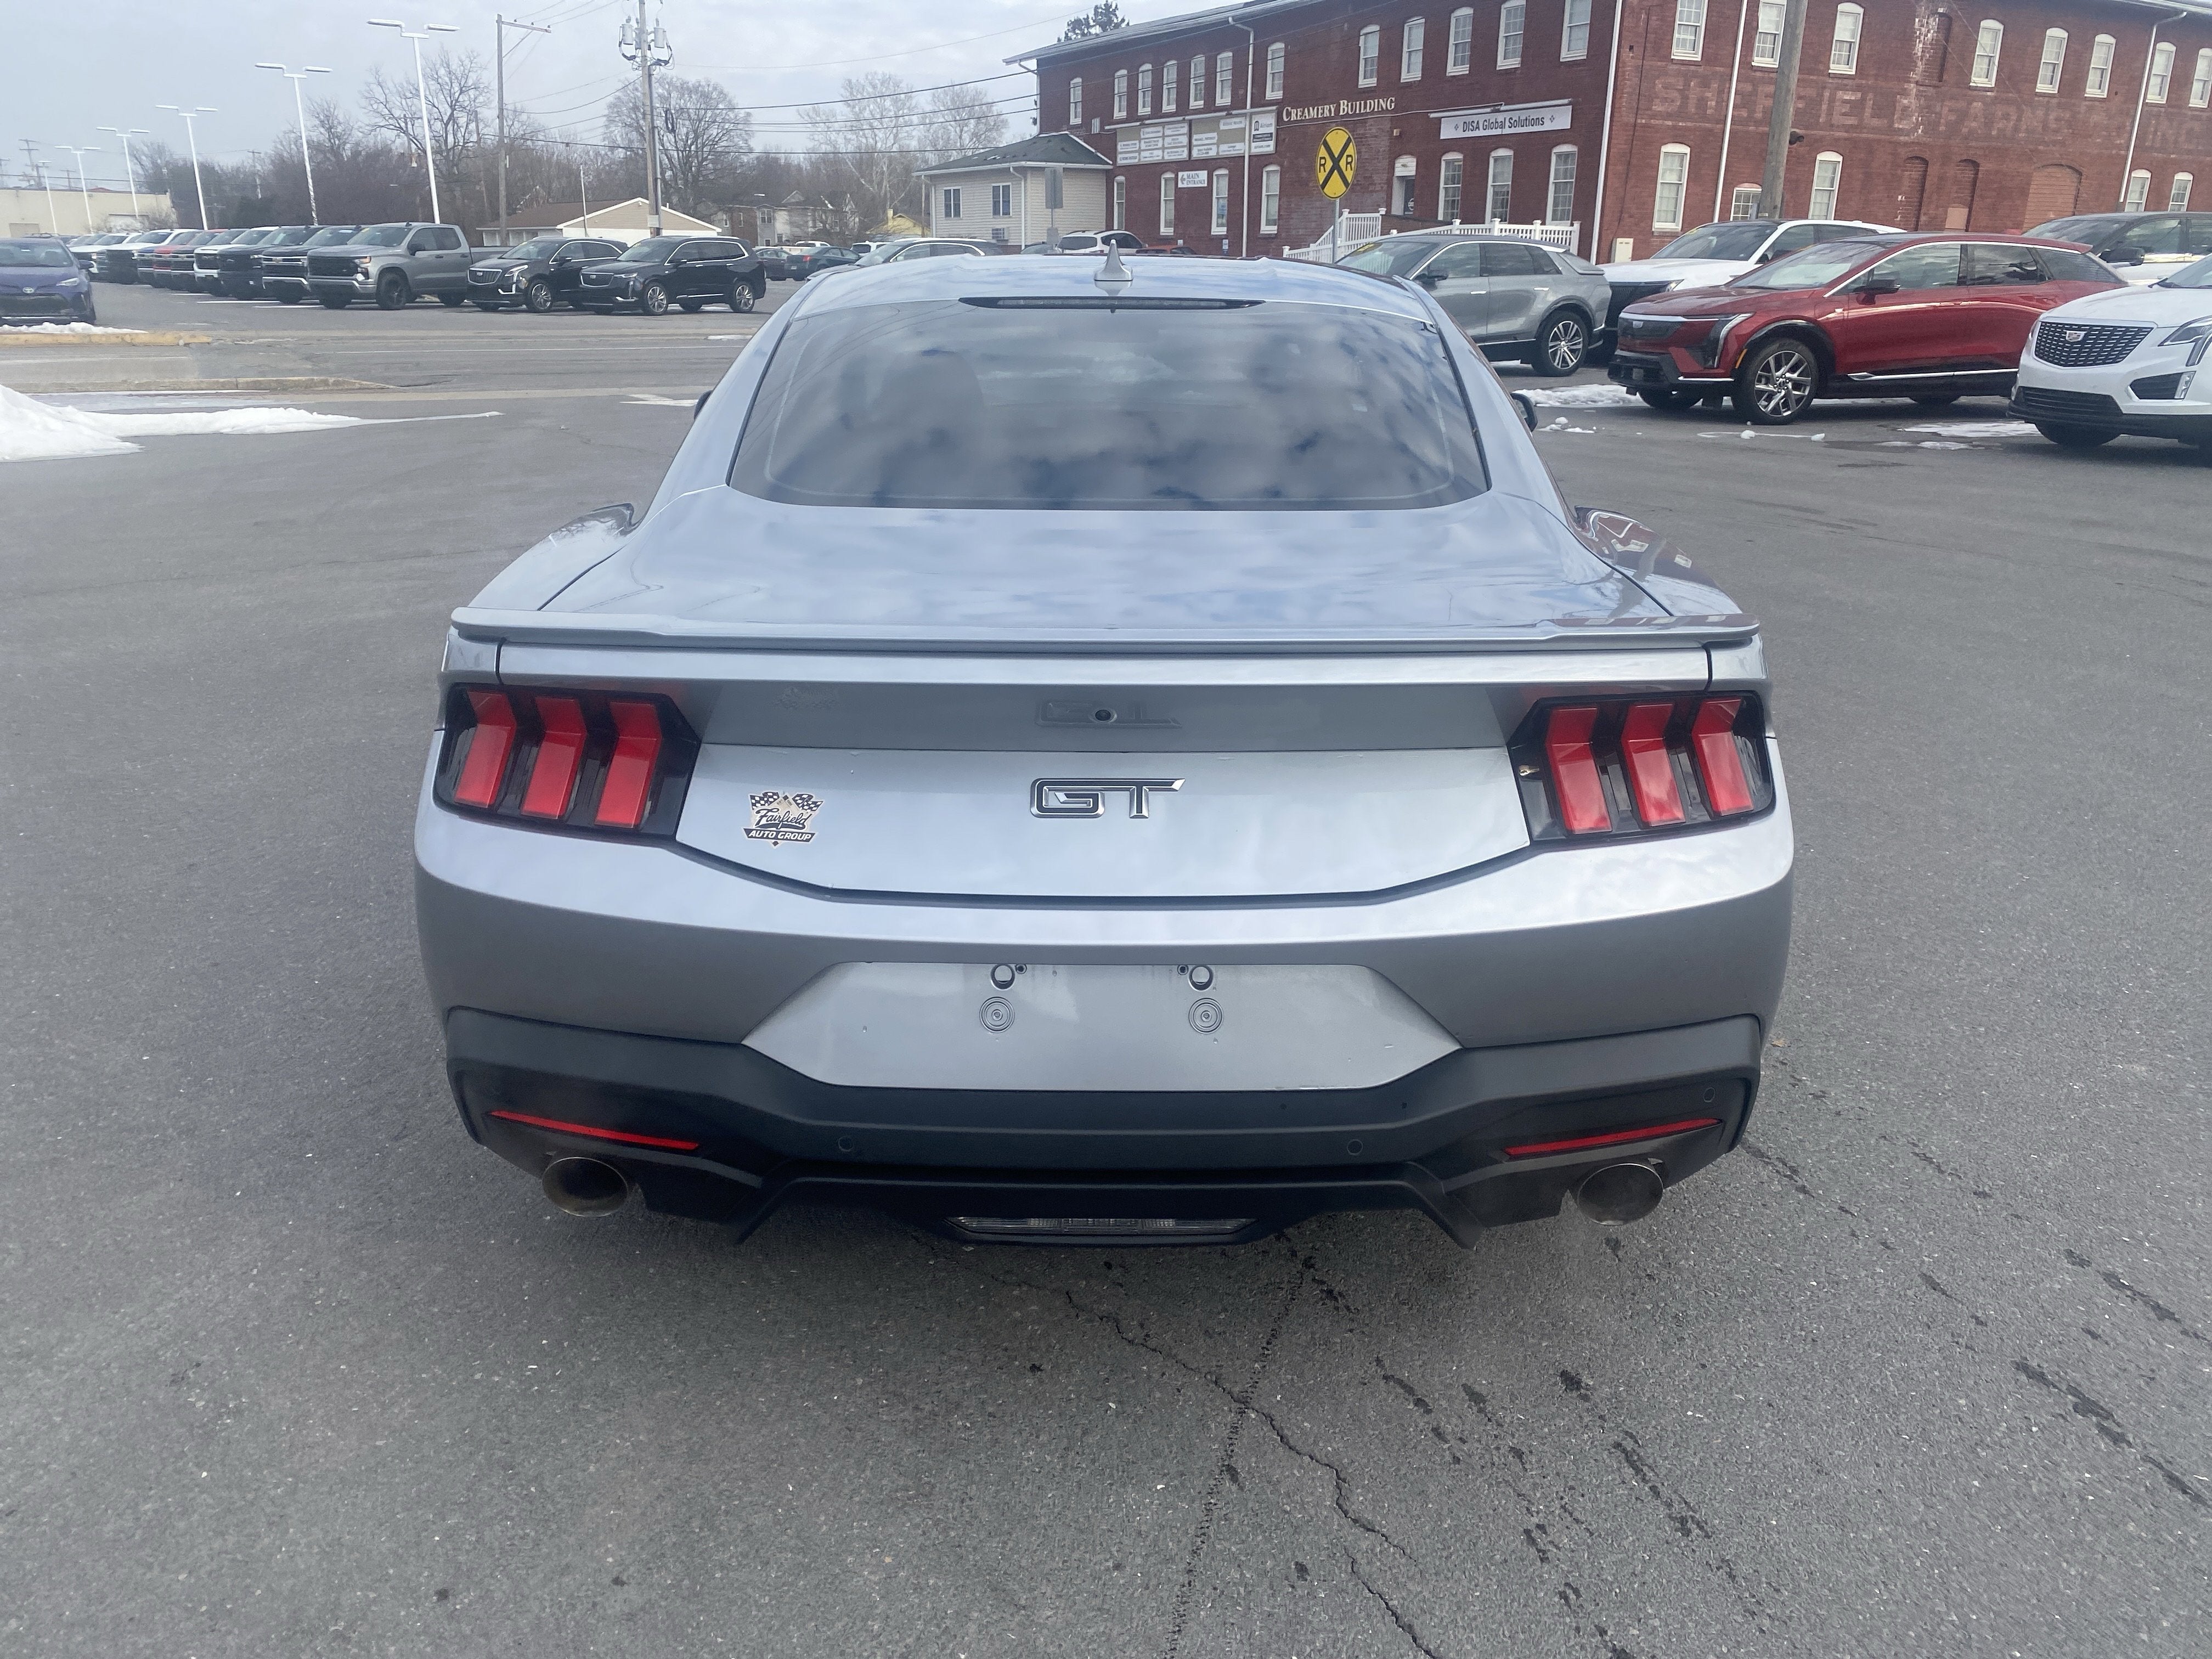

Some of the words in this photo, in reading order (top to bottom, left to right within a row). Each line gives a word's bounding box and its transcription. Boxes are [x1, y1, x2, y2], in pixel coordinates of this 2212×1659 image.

[1463, 120, 1480, 132] DISA
[1482, 117, 1506, 131] Global
[1508, 115, 1545, 128] Solutions
[1319, 156, 1327, 173] R
[1345, 154, 1353, 172] R
[1030, 777, 1186, 819] GT
[755, 808, 812, 830] Fairfield
[748, 830, 776, 838] AUTO
[777, 832, 811, 840] GROUP
